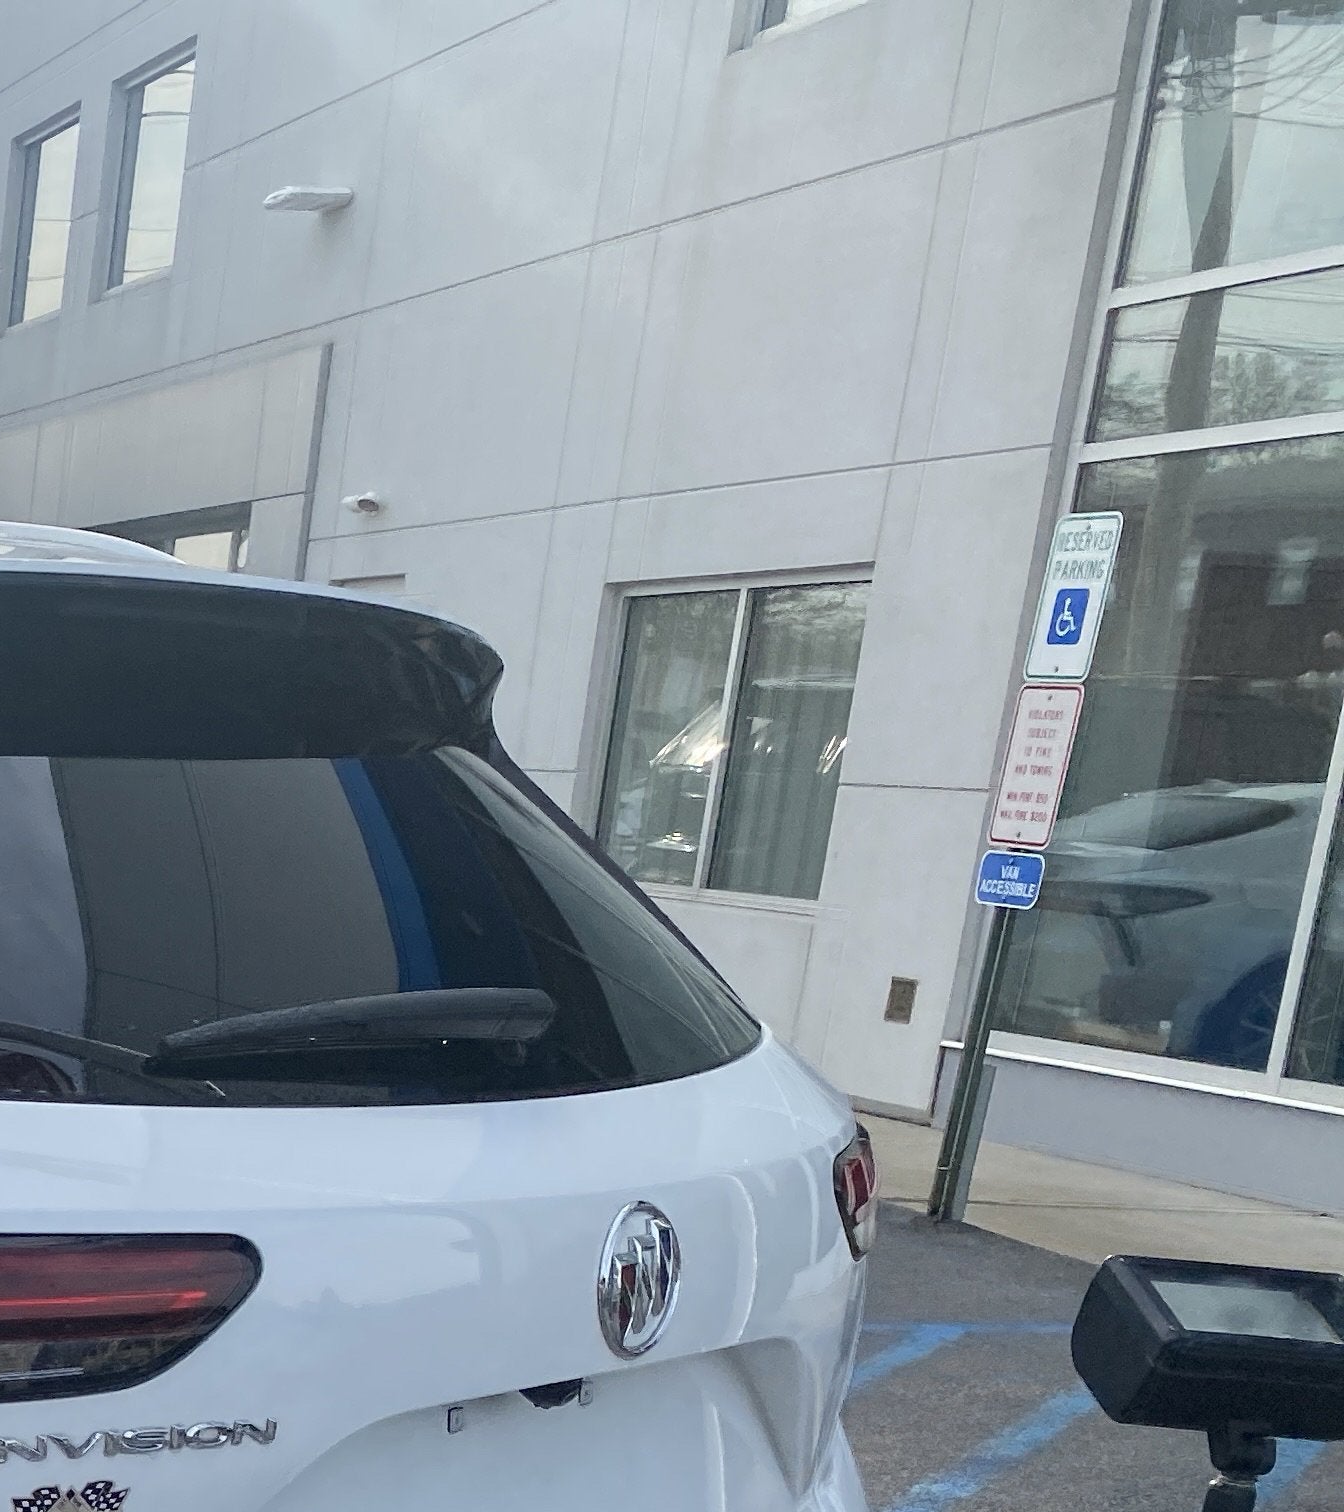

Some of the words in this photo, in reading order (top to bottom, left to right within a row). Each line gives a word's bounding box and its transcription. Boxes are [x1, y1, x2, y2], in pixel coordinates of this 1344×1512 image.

[1056, 530, 1114, 552] RESERVED
[1053, 559, 1106, 580] PARKING
[1001, 864, 1021, 881] VAN
[979, 878, 1037, 898] ACCESSIBLE
